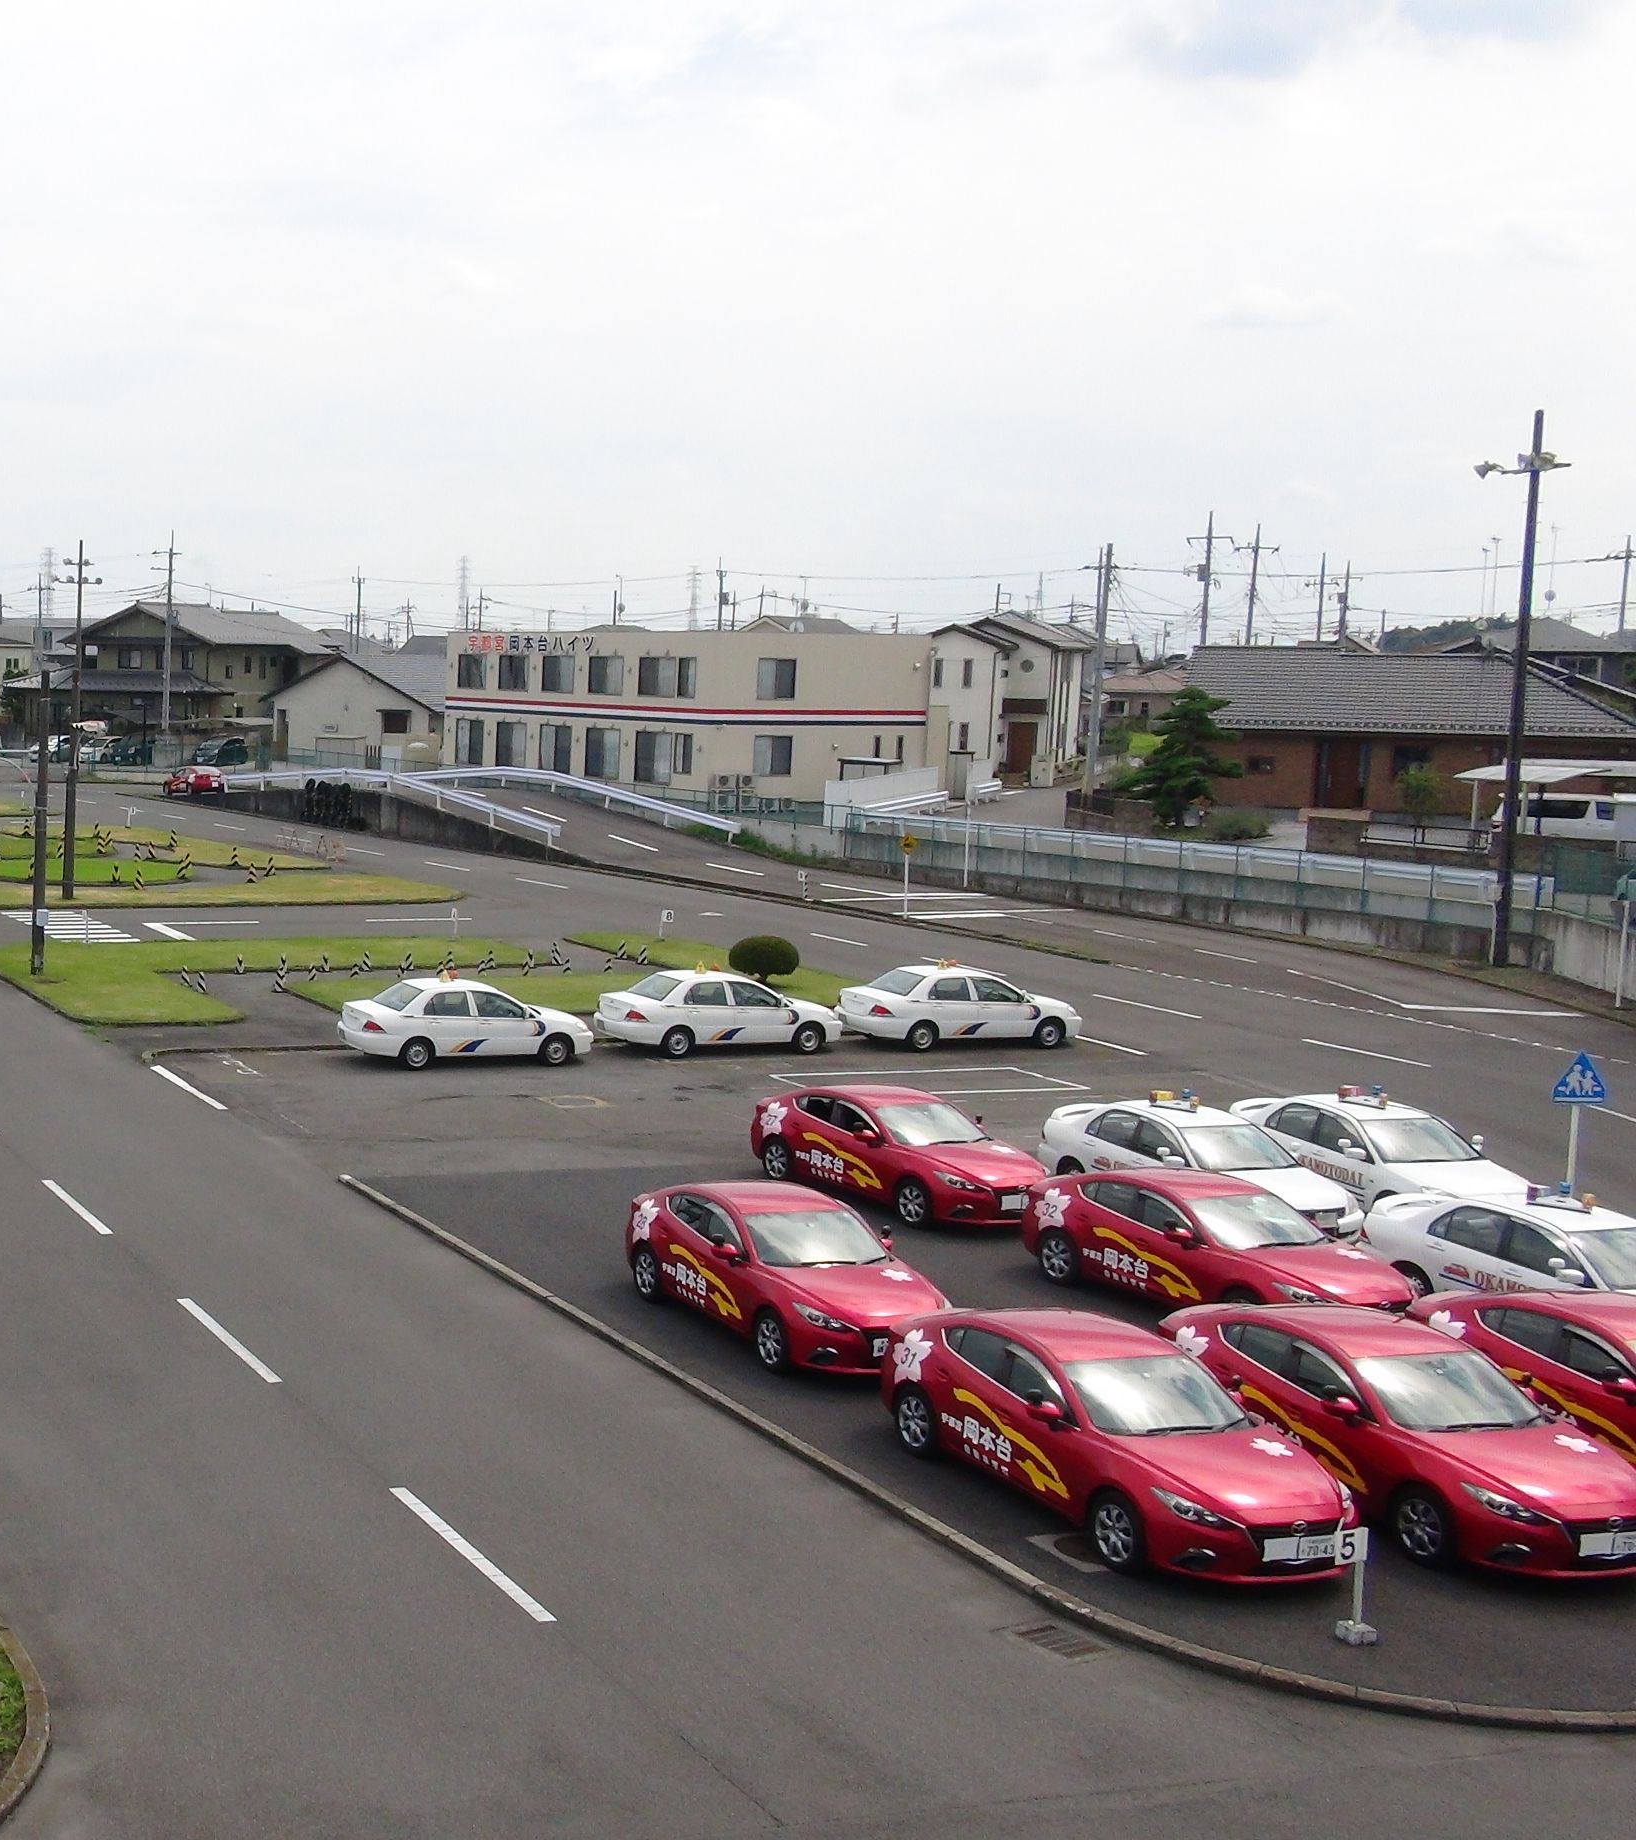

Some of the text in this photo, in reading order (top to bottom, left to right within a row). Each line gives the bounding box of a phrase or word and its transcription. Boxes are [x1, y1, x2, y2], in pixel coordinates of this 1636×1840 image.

[666, 911, 673, 921] 8
[1042, 1202, 1058, 1218] 32
[1102, 1246, 1150, 1280] 岡本台
[676, 1262, 707, 1297] 岡本台
[901, 1346, 918, 1368] 31
[963, 1414, 1013, 1463] 岡本台
[1340, 1532, 1355, 1560] 5
